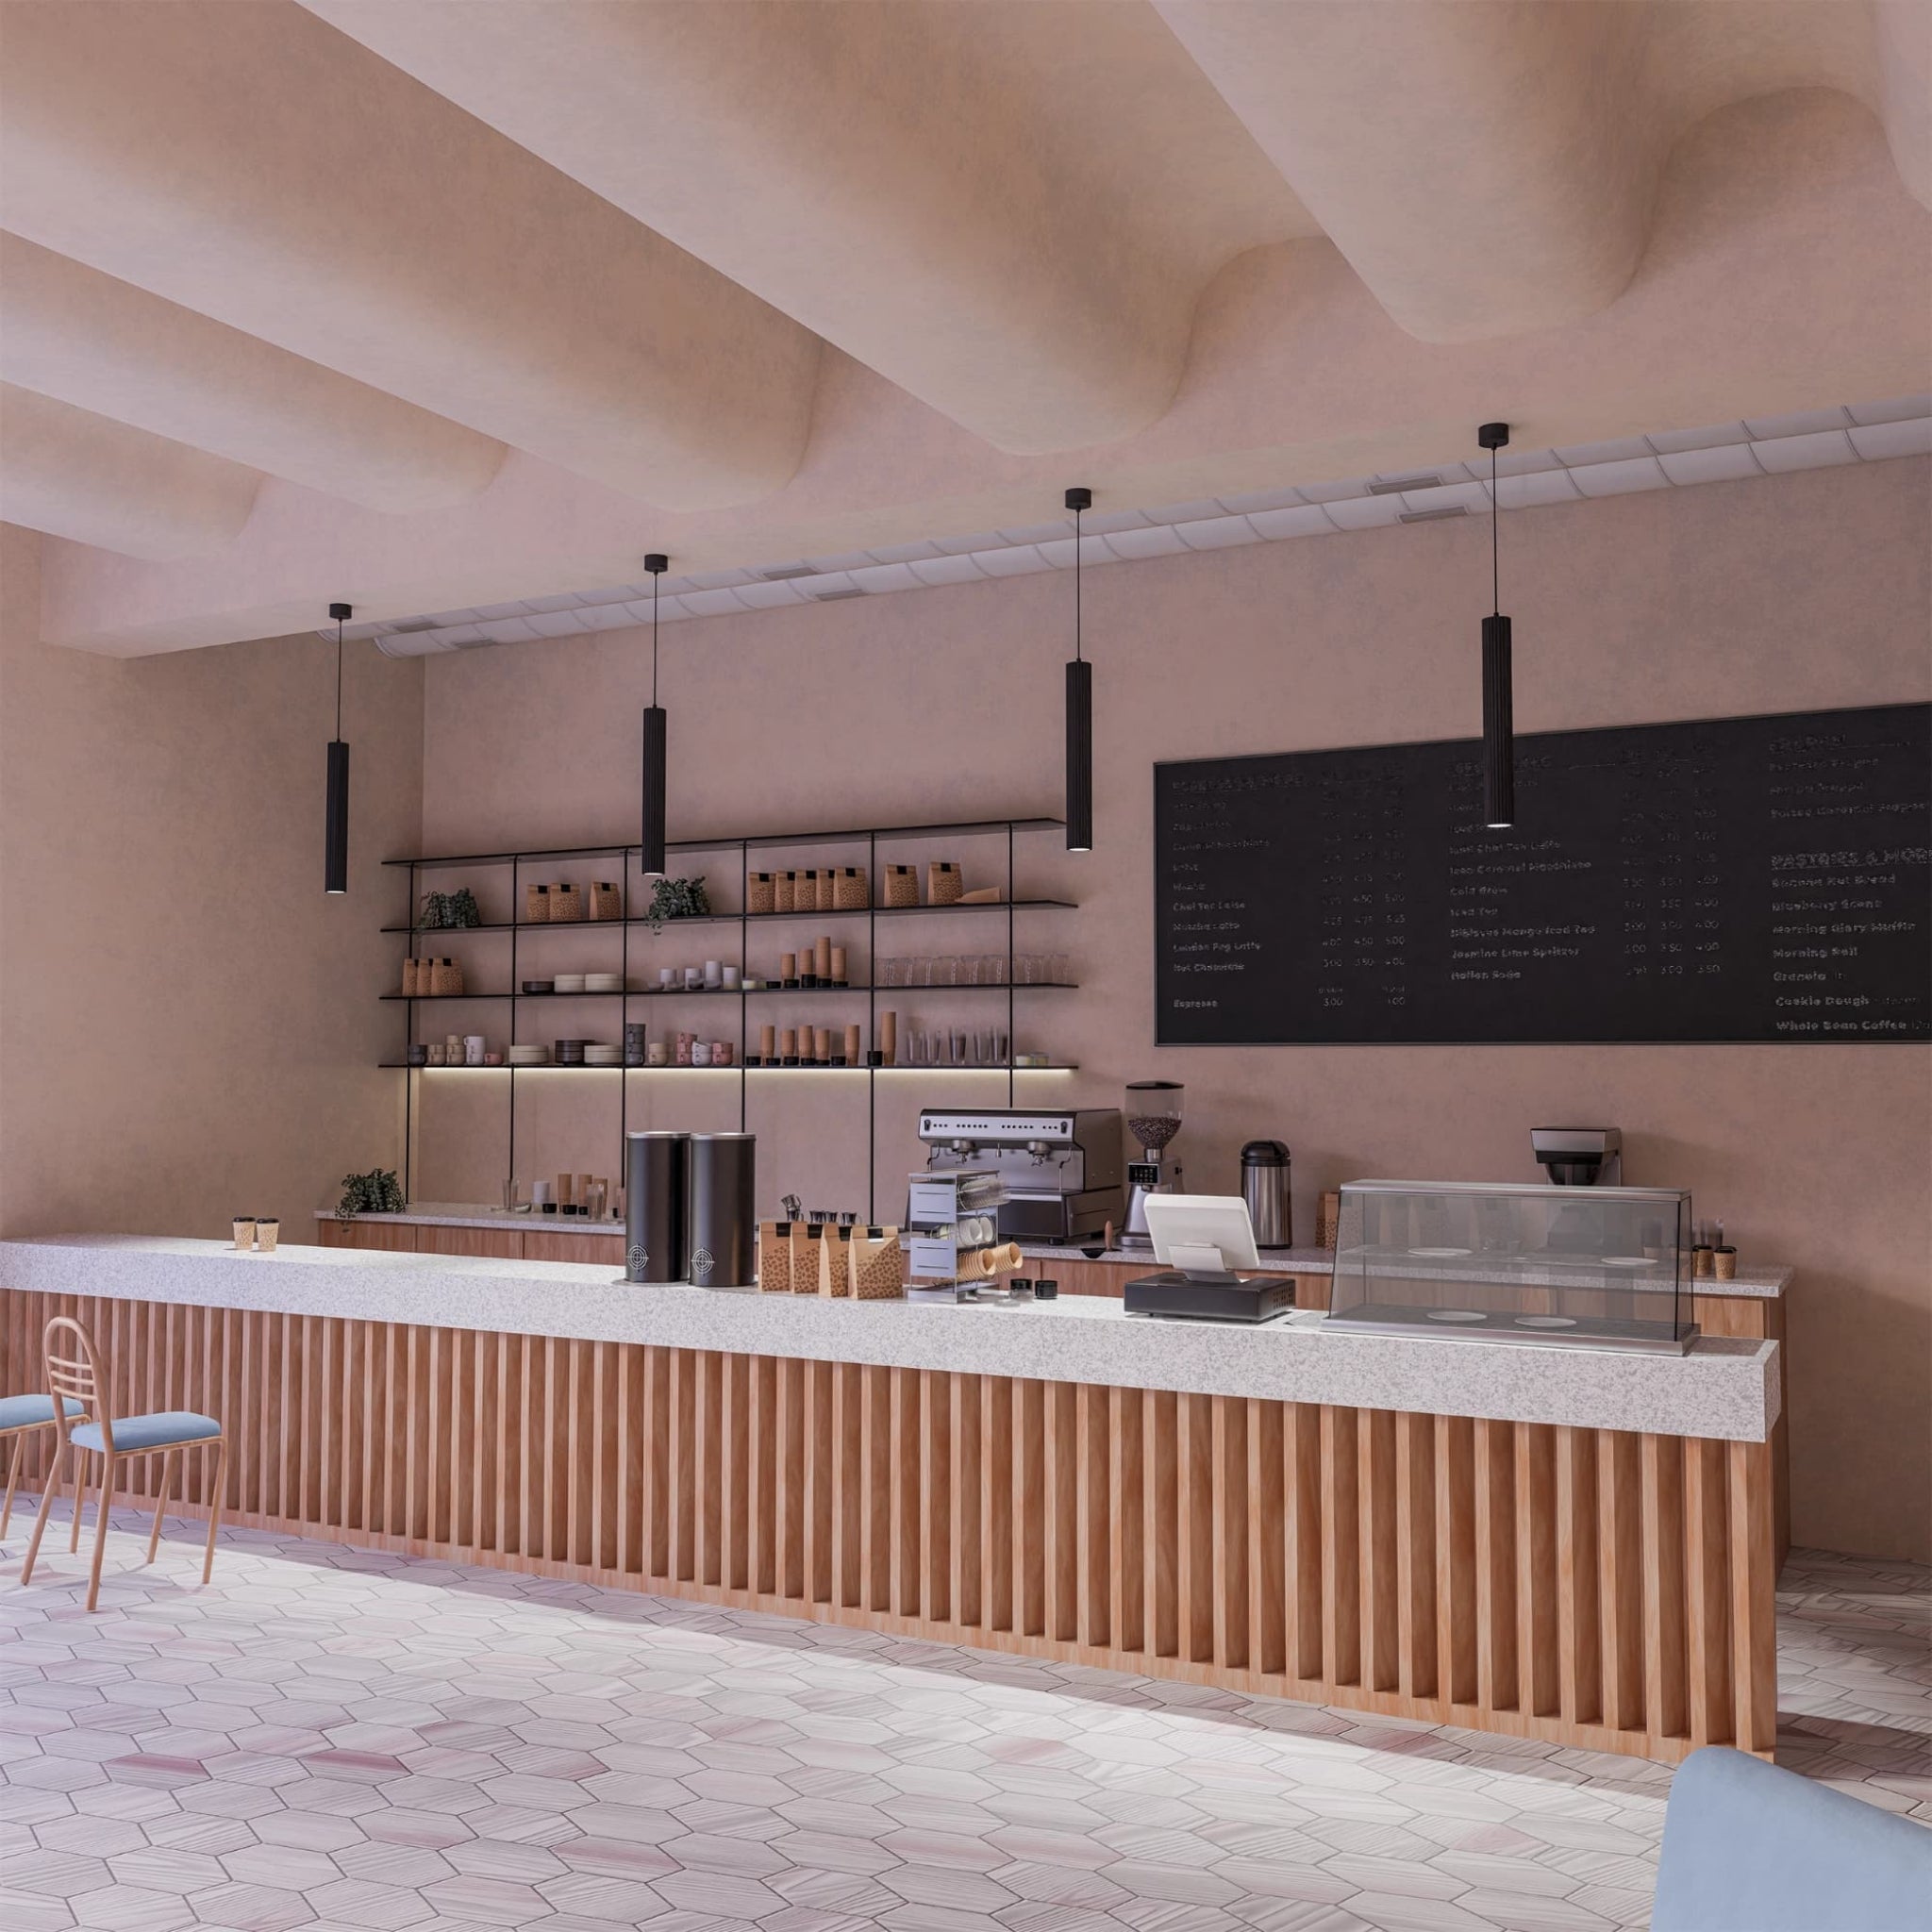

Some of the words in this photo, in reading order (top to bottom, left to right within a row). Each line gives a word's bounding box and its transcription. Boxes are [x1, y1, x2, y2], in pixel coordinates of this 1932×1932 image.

[1774, 995, 1822, 1007] Cookie
[1824, 994, 1870, 1007] Dough
[1775, 1020, 1820, 1031] Whole
[1861, 1019, 1907, 1031] Coffee
